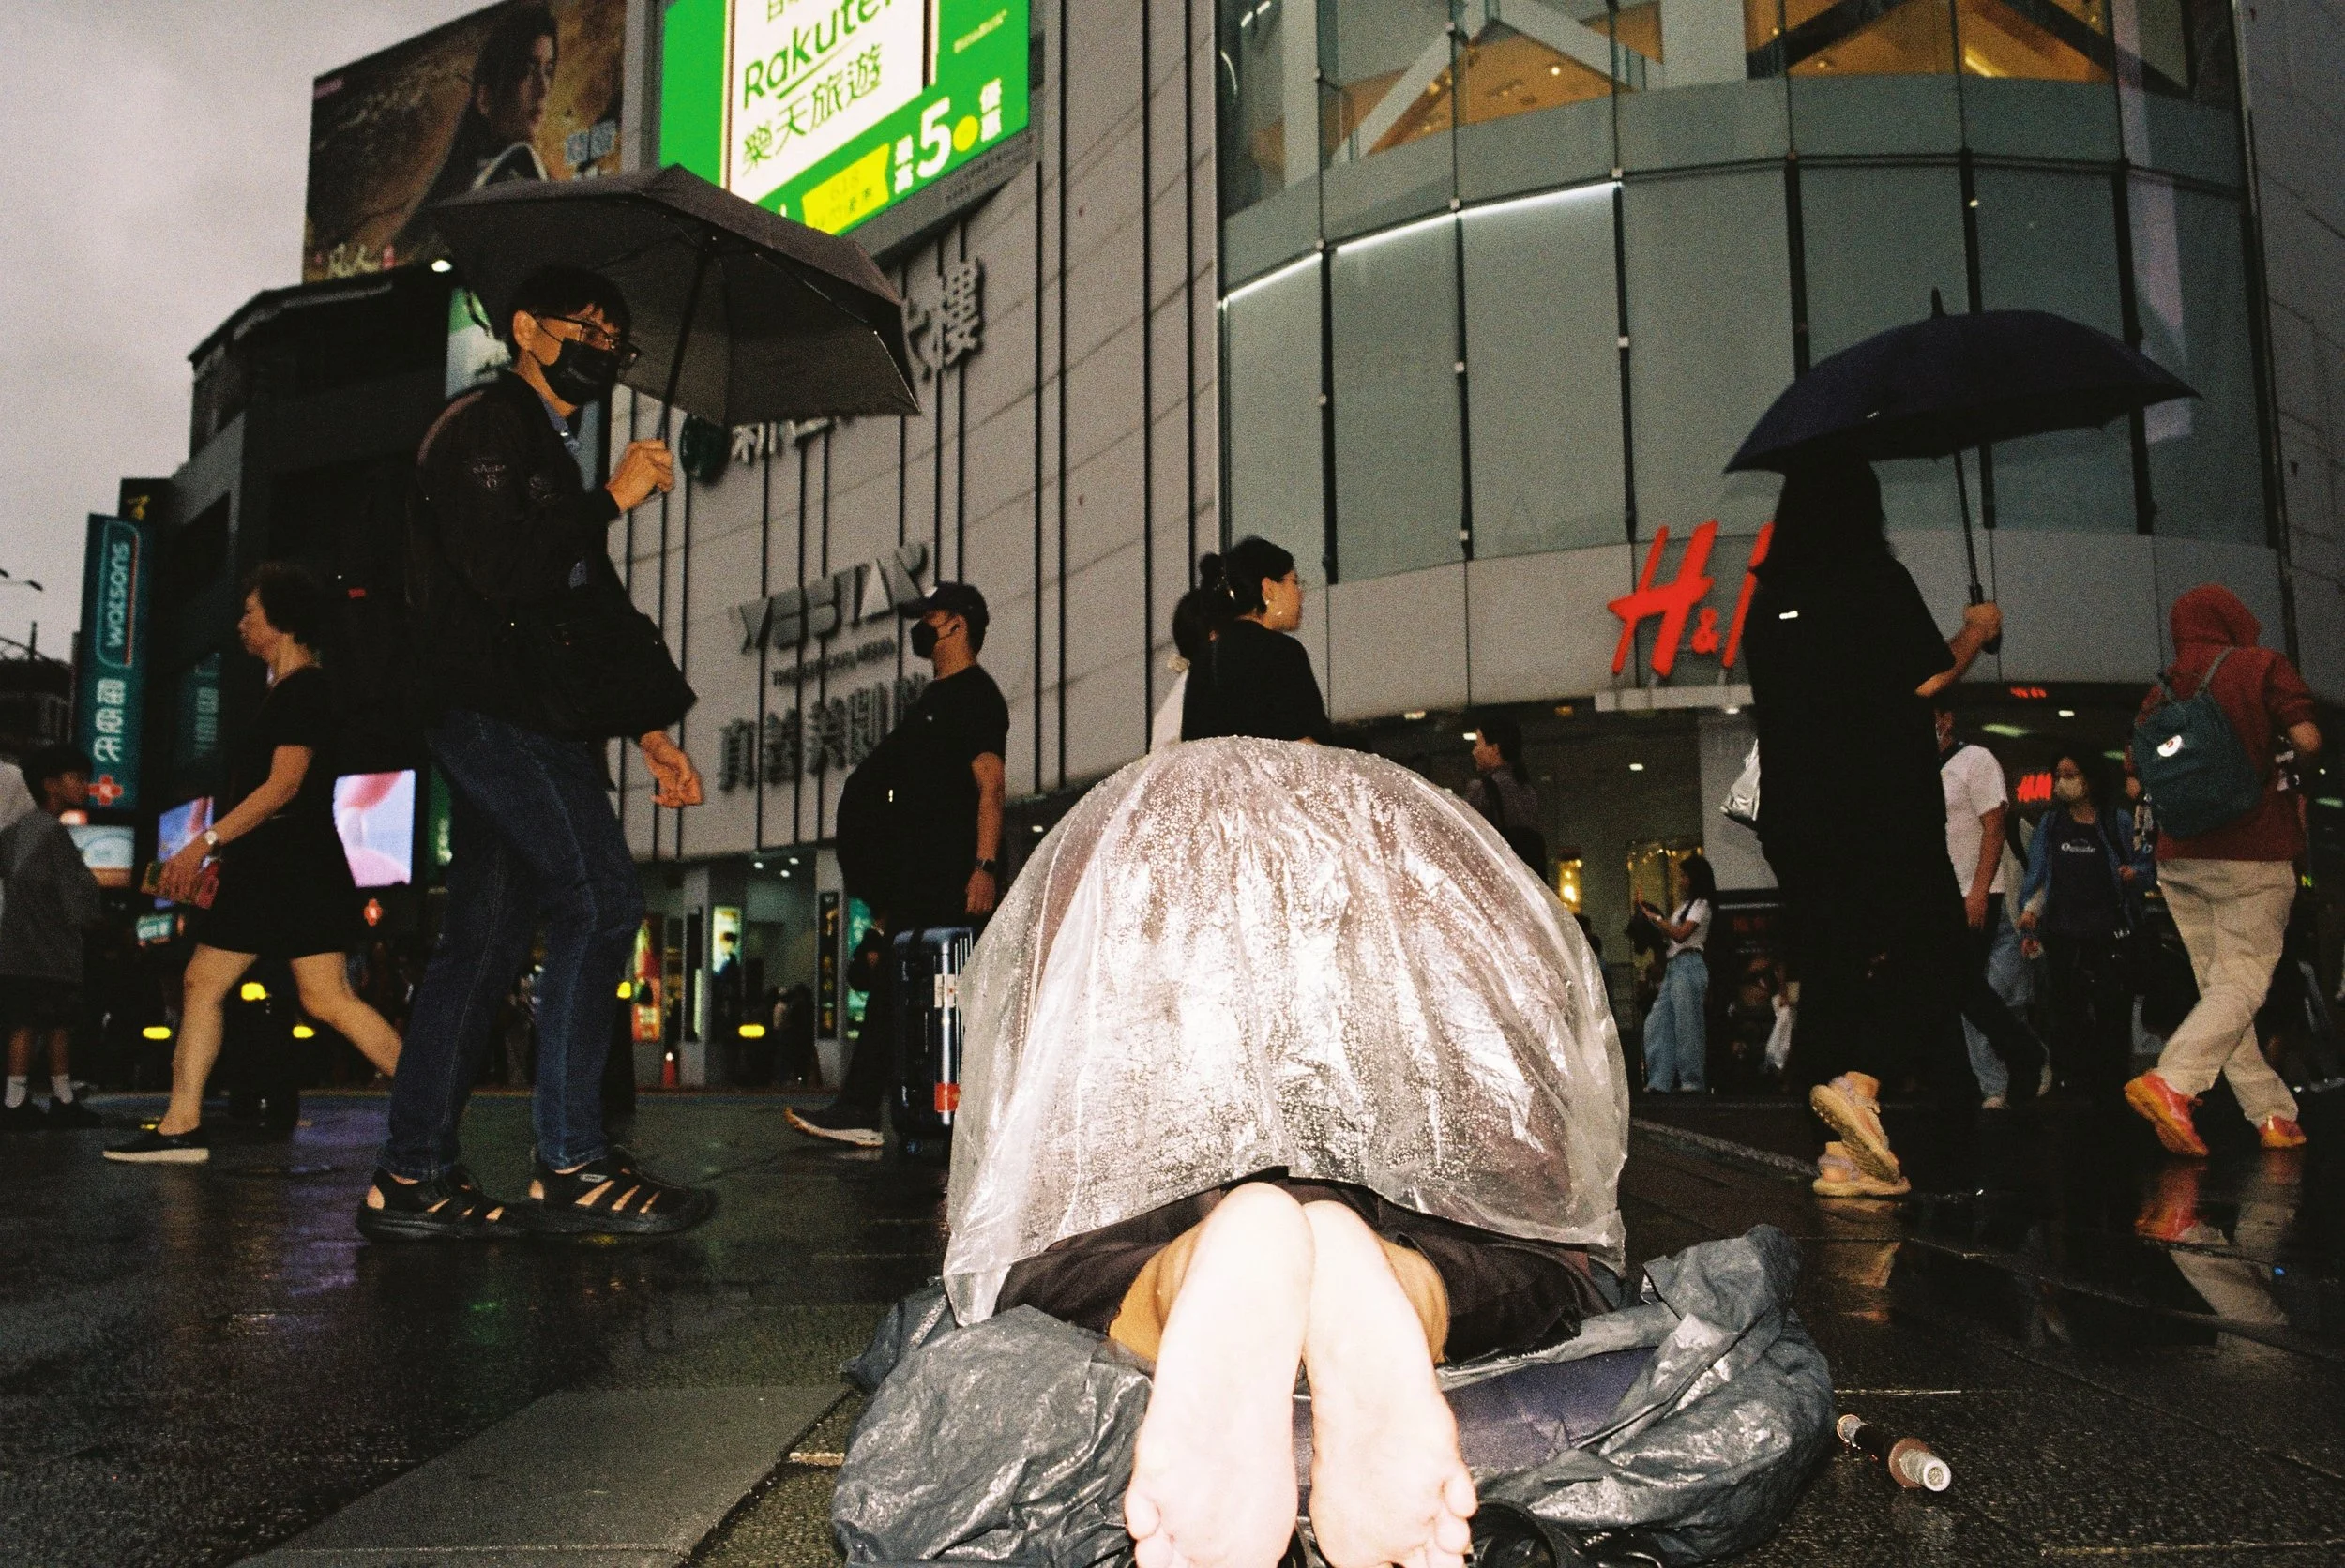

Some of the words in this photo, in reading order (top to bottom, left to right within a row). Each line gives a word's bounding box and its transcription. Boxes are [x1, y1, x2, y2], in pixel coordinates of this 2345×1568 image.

[742, 43, 883, 176] 樂天旅遊
[744, 0, 891, 110] Rakute
[915, 96, 953, 178] 5
